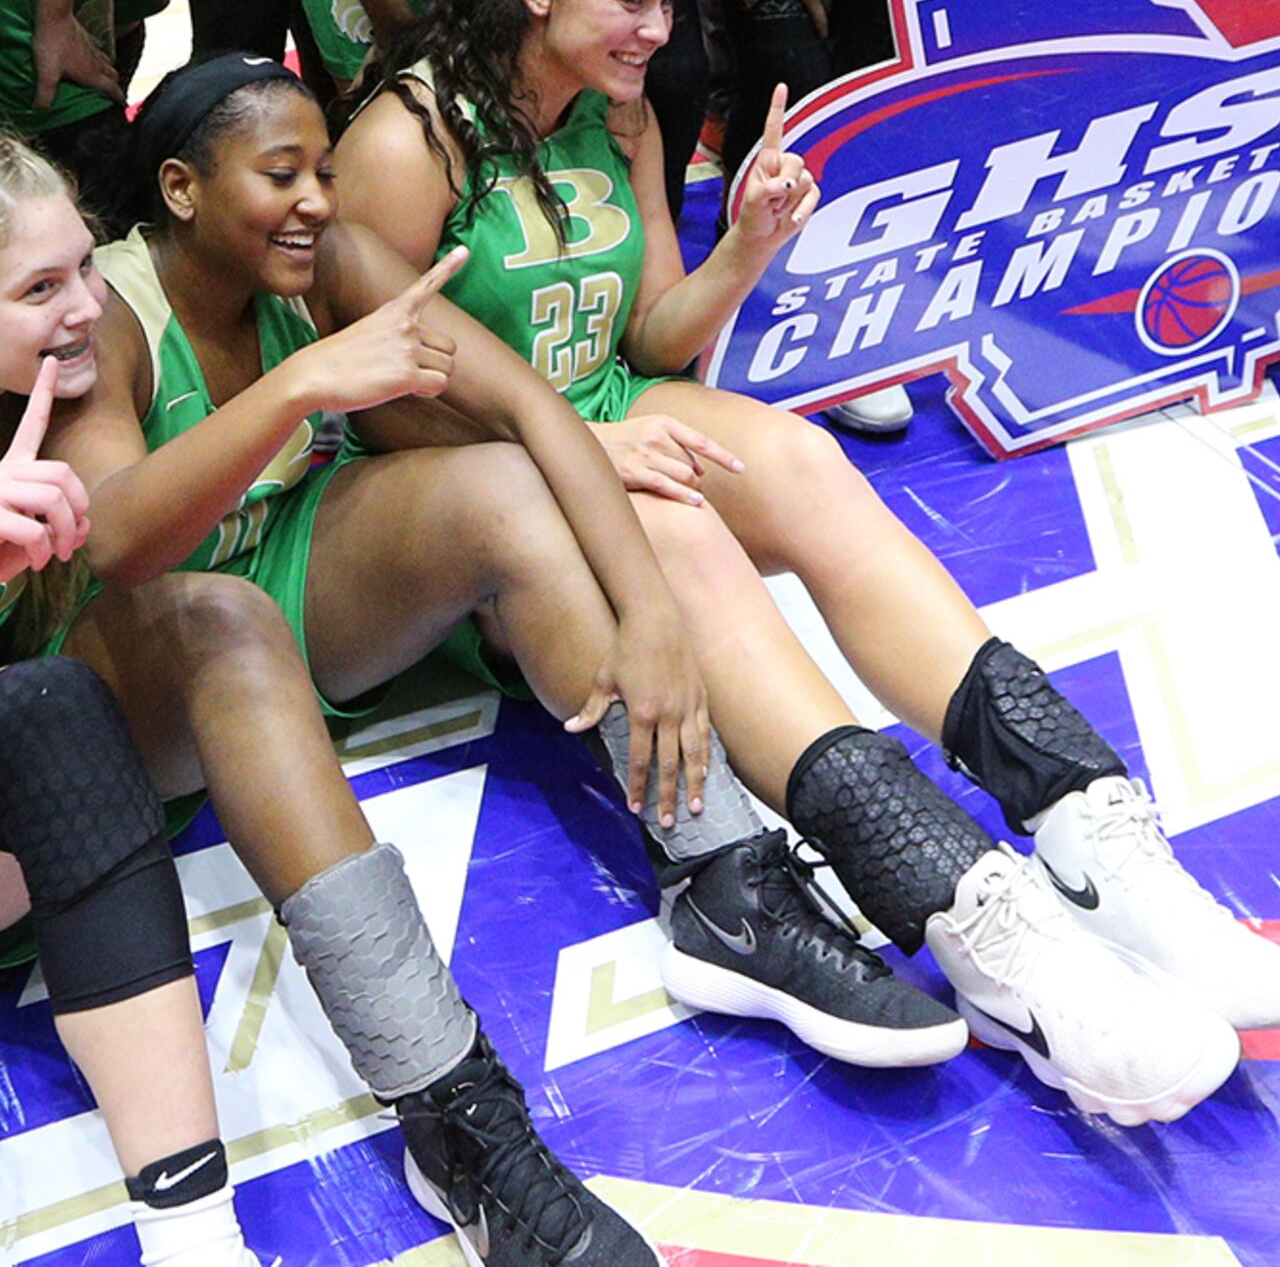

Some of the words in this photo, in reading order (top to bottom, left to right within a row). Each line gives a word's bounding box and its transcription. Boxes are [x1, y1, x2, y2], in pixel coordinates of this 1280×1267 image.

[486, 168, 632, 271] B
[771, 230, 987, 316] STATE
[531, 271, 625, 394] 23
